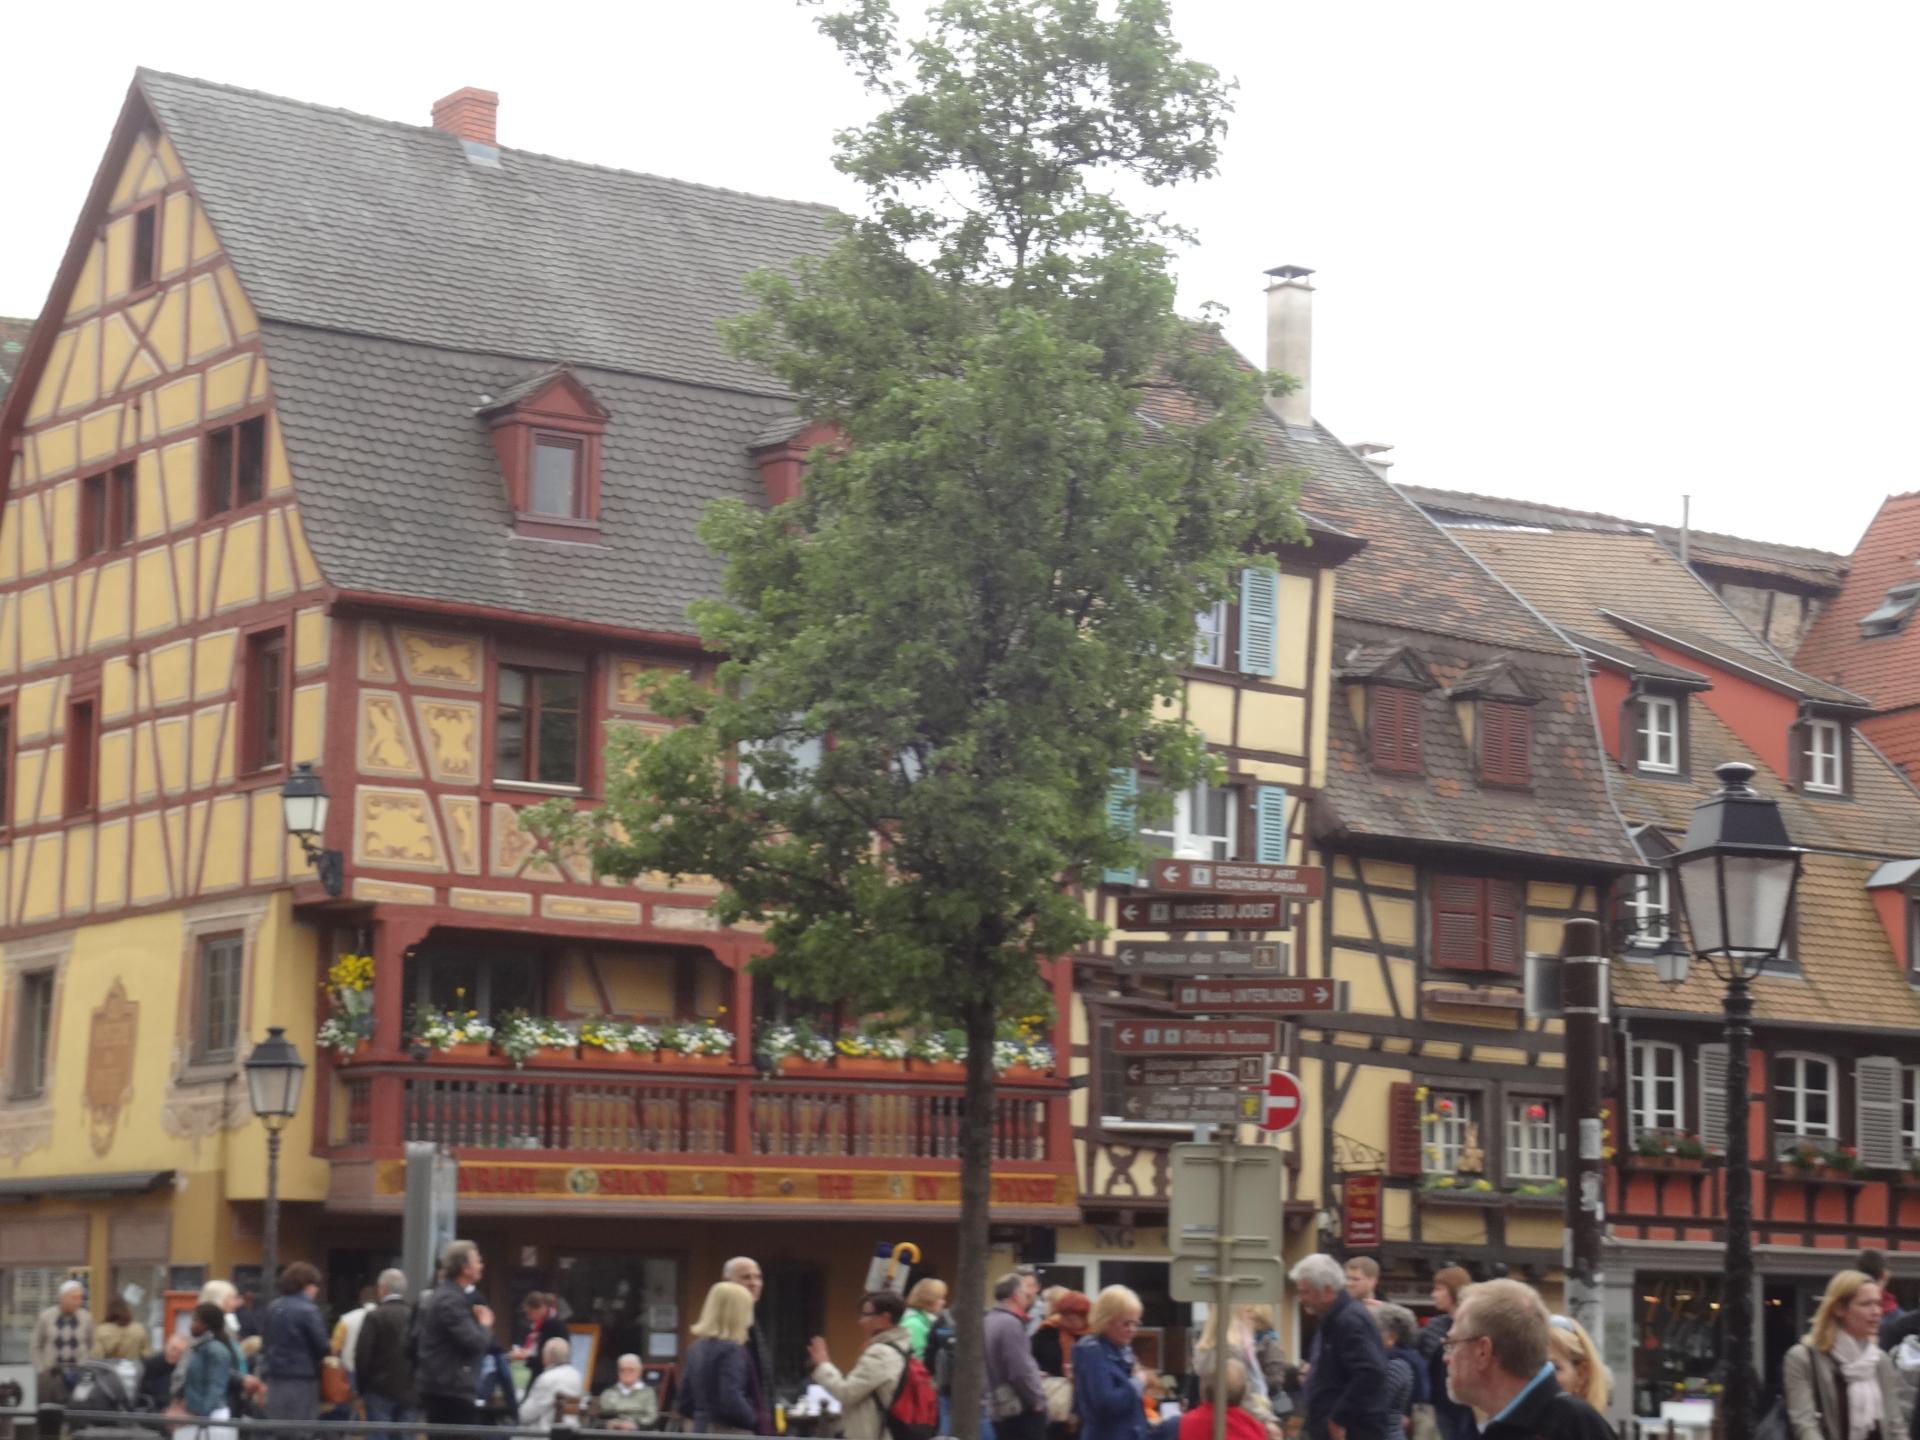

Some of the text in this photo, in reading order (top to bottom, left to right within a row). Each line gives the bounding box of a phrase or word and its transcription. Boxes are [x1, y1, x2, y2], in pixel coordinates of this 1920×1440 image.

[1215, 865, 1259, 879] ESPACE
[1215, 878, 1308, 894] CONTEMPORAIN
[1174, 902, 1275, 919] MUSÉE DU JOUET
